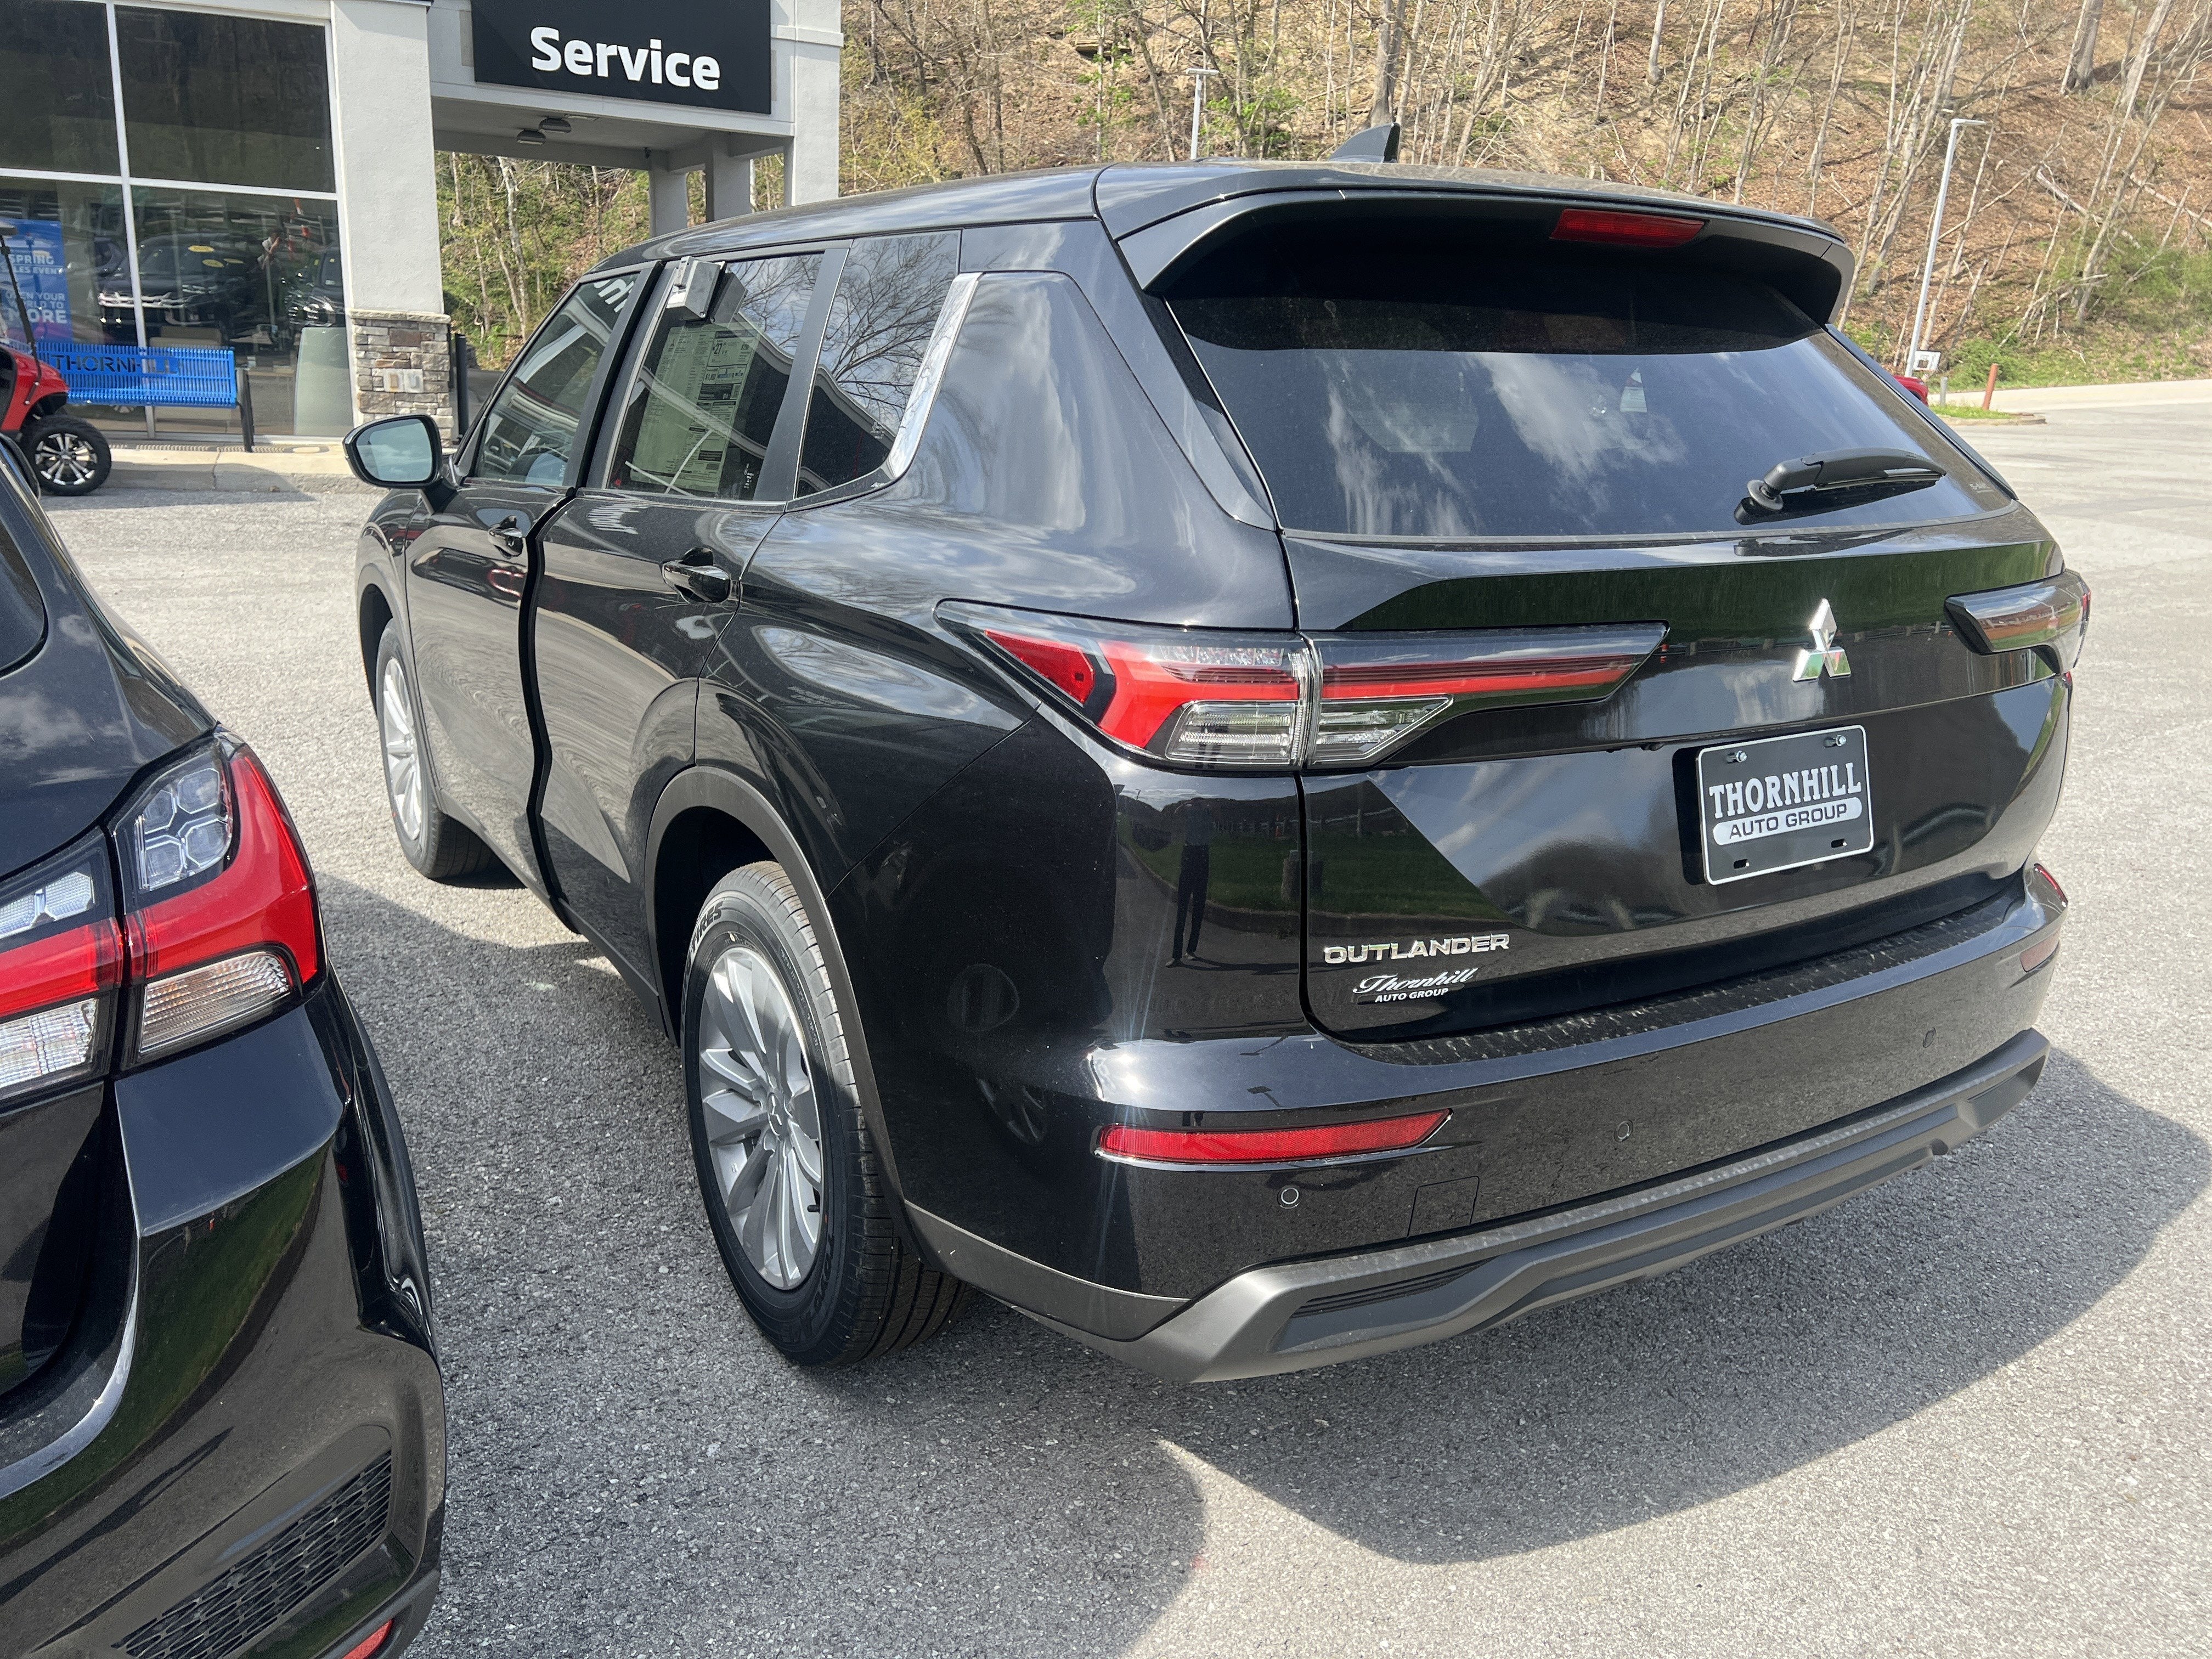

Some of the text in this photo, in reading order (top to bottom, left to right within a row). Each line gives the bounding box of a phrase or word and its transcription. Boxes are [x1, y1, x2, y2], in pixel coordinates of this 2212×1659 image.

[530, 26, 720, 90] Service
[1, 264, 30, 273] SLES
[8, 253, 54, 265] SPRING
[5, 291, 65, 301] OEN YOUR
[51, 354, 177, 374] THORNHILL
[1709, 762, 1861, 819] THORNHILL
[1730, 803, 1847, 839] AUTO GROUP
[690, 900, 724, 952] TIRES
[1324, 934, 1510, 964] OUTLANDER
[1352, 968, 1479, 994] Thornhill
[1374, 988, 1449, 1003] AUTO GROUP
